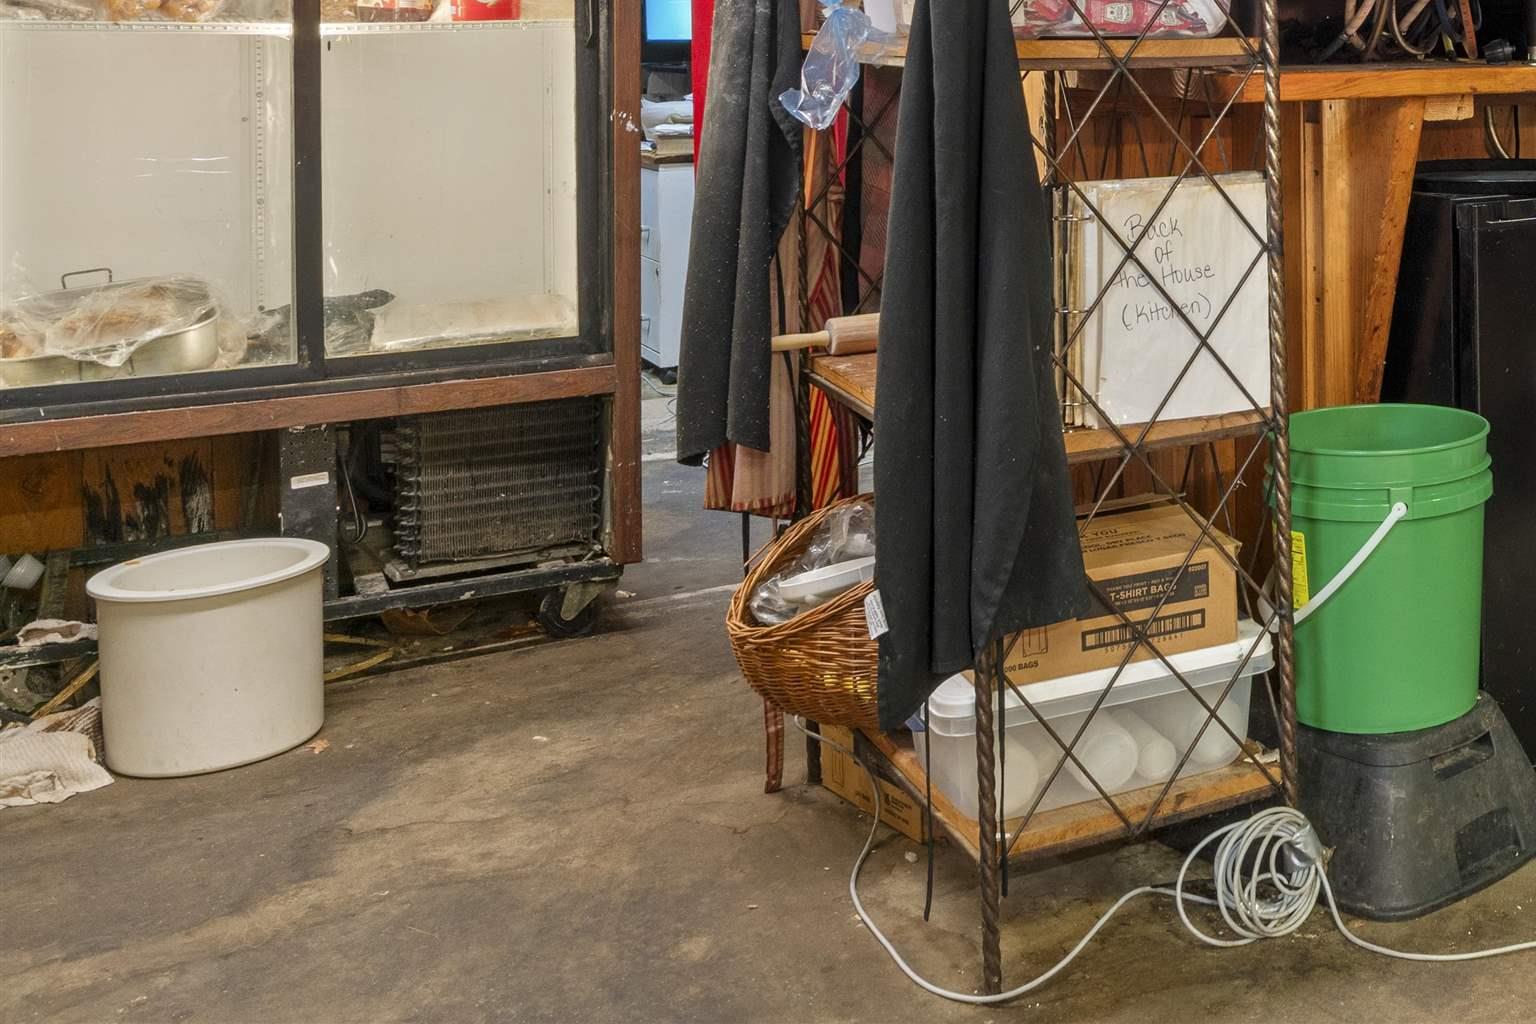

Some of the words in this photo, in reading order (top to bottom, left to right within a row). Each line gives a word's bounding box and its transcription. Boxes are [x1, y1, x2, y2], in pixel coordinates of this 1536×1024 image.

[1124, 214, 1183, 244] Back
[1162, 263, 1216, 288] House
[1110, 586, 1148, 601] T-SHIRT
[1018, 660, 1039, 671] BAGS
